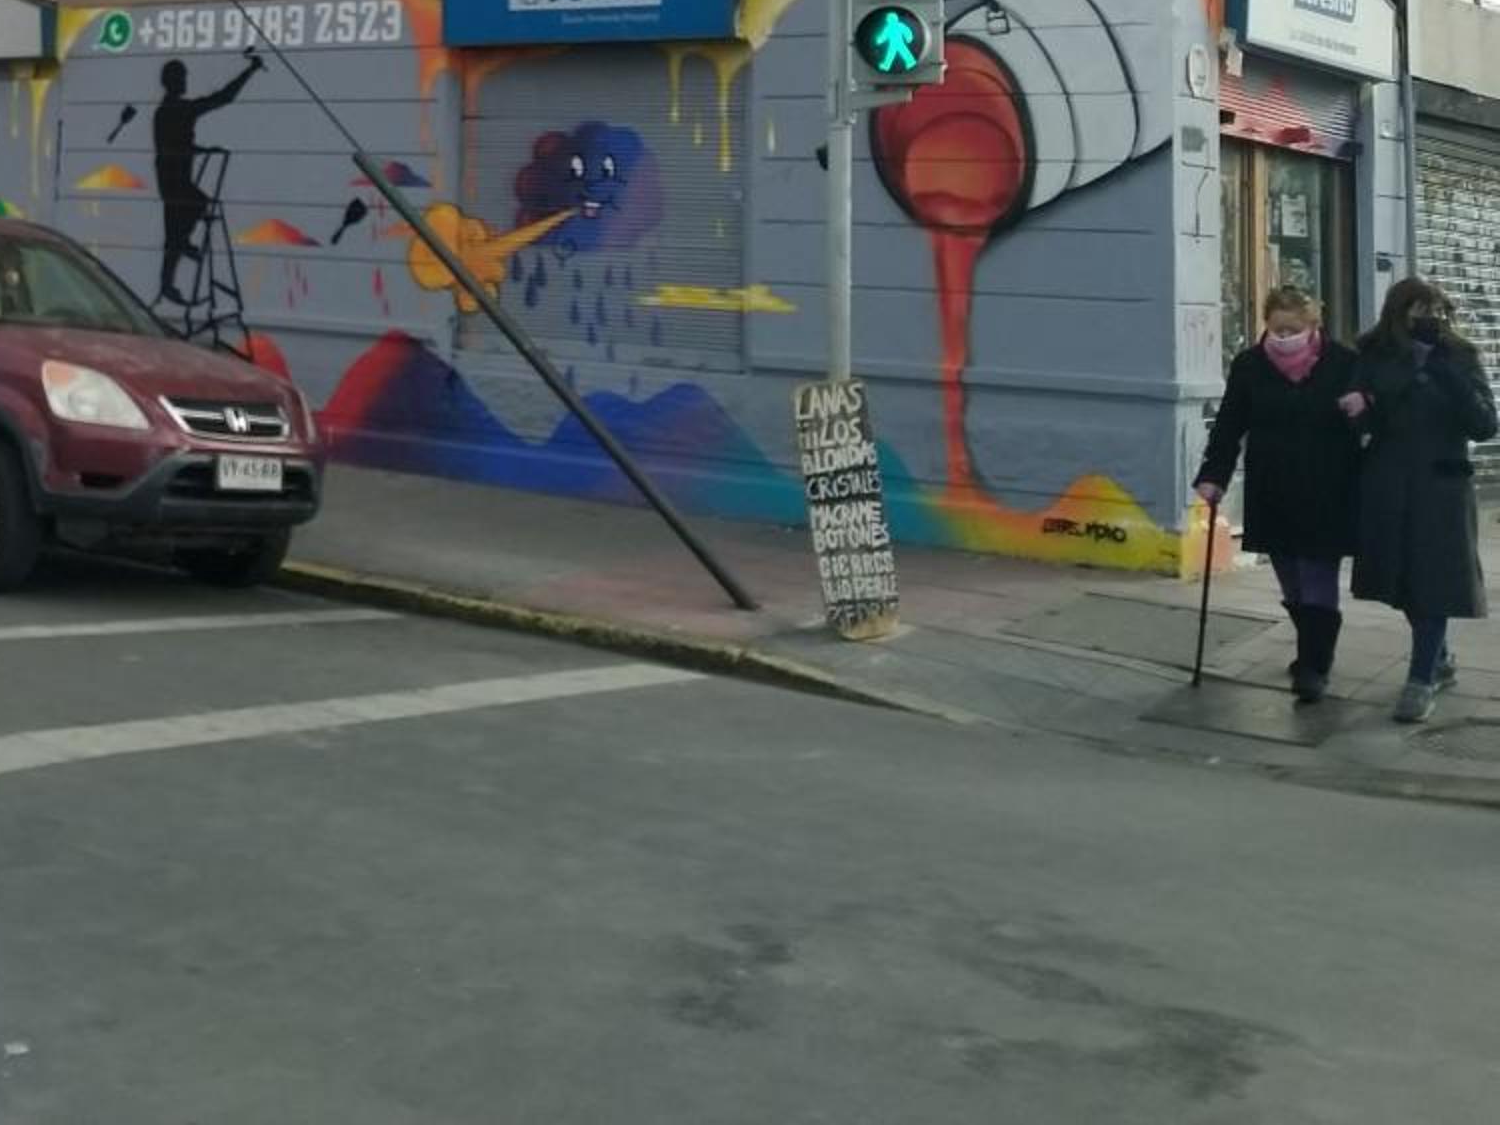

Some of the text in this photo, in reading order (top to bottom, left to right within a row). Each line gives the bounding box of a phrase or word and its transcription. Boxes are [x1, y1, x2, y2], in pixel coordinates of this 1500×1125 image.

[139, 0, 402, 49] +569 9783 2523
[795, 382, 863, 420] LANAS
